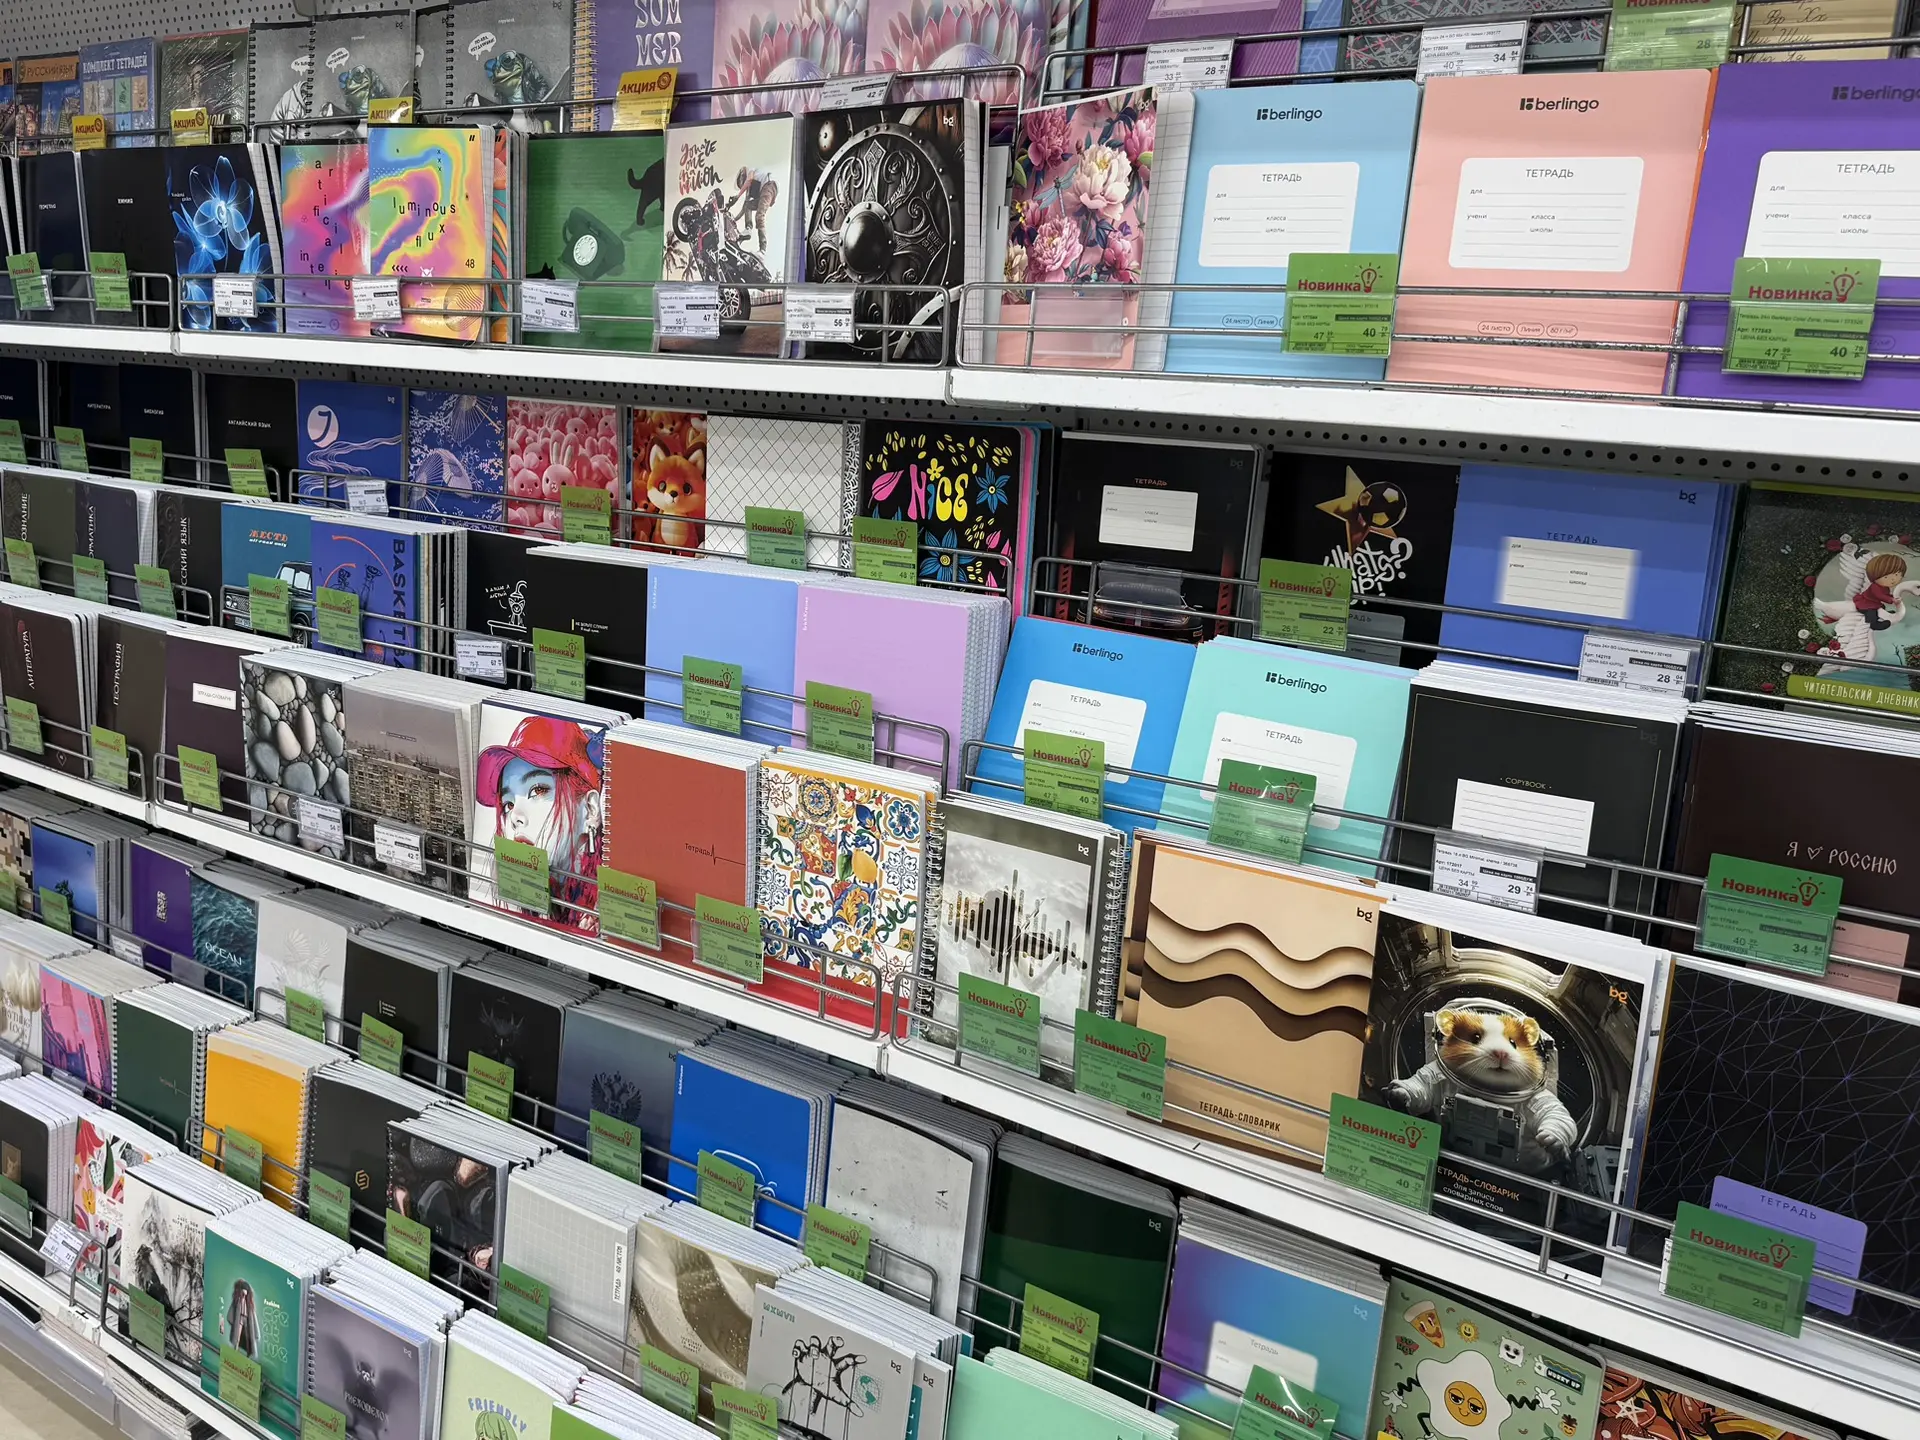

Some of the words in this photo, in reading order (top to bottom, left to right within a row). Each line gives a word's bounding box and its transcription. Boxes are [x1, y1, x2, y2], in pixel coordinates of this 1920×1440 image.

[636, 32, 682, 66] MER
[1493, 53, 1506, 62] 34
[83, 58, 115, 74] КОМПЛЕКТ
[1205, 67, 1216, 75] 28
[620, 81, 656, 95] АКЦИЯ
[1535, 97, 1599, 112] berlingo
[1269, 108, 1322, 122] berlingo
[75, 124, 95, 134] АКЦИЯ
[174, 117, 196, 129] АКЦИЯ
[1526, 169, 1574, 178] ТЕТРАДЬ
[1836, 163, 1896, 174] ТЕТРАДЬ
[1262, 173, 1302, 183] ТЕТРАДЬ
[1765, 212, 1790, 220] учени
[1840, 227, 1868, 235] школы
[465, 258, 475, 269] 48
[1298, 279, 1361, 292] Новинка
[1748, 285, 1833, 301] Новинка
[1363, 328, 1376, 337] 40
[1765, 348, 1779, 357] 47
[1830, 347, 1847, 357] 40
[1135, 478, 1168, 486] ТЕТРАДЬ
[566, 500, 597, 510] Новинка
[1679, 490, 1697, 505] bg
[751, 523, 787, 534] Новинка
[860, 534, 899, 547] Новинка
[1547, 532, 1598, 544] ТЕТРАДЬ
[1269, 579, 1323, 595] Новинка
[1323, 626, 1334, 635] 22
[539, 643, 571, 657] Новинка
[1082, 644, 1123, 662] berlingo
[689, 673, 723, 688] Новинка
[1278, 674, 1327, 694] berlingo
[1657, 674, 1670, 683] 28
[1070, 695, 1102, 708] ТЕТРАДЬ
[1803, 680, 1872, 701] ЧИТАТЕЛЬСКИЙ
[1876, 691, 1919, 708] ДНЕВНИК
[812, 699, 852, 716] Новинка
[1265, 730, 1303, 744] ТЕТРАДЬ
[1033, 749, 1080, 766] Новинка
[1505, 777, 1546, 790] COPYBOOK
[685, 843, 712, 857] Тетрадь
[1078, 844, 1089, 856] bg
[1787, 841, 1798, 857] Я
[500, 852, 532, 870] Новинка
[1459, 879, 1468, 887] 34
[1508, 884, 1521, 894] 29
[1722, 877, 1799, 903] Новинка
[603, 883, 639, 901] Новинка
[703, 911, 741, 931] Новинка
[1357, 907, 1372, 923] bg
[1733, 937, 1745, 946] 40
[1793, 943, 1808, 954] 34
[205, 941, 242, 966] OCEAN
[1609, 986, 1628, 1004] bg
[968, 991, 1015, 1015] Новинка
[1085, 1033, 1138, 1060] Новинка
[473, 1066, 506, 1086] Новинка
[1199, 1101, 1281, 1132] ТЕТРАДЬ-СЛОВАРИК
[595, 1125, 625, 1144] Новинка
[1341, 1115, 1406, 1145] Новинка
[703, 1166, 737, 1189] Новинка
[1438, 1166, 1519, 1201] ЕТРАДЬ-СЛОВАРИК
[1485, 1202, 1504, 1212] слов
[1760, 1195, 1817, 1220] ТЕТРАДЬ
[813, 1220, 850, 1244] Новинка
[1148, 1218, 1161, 1232] bg
[391, 1224, 422, 1245] Новинка
[1690, 1228, 1770, 1263] Новинка
[1752, 1298, 1768, 1310] 28
[1032, 1303, 1076, 1331] Новинка
[1250, 1339, 1279, 1355] Тетрадь
[648, 1359, 690, 1385] Новинка
[890, 1359, 901, 1374] bg
[923, 1373, 934, 1388] bg
[1547, 1370, 1570, 1385] HURRY
[1570, 1379, 1581, 1389] UP
[467, 1397, 528, 1433] FRIENDLY
[721, 1399, 768, 1420] Новинка
